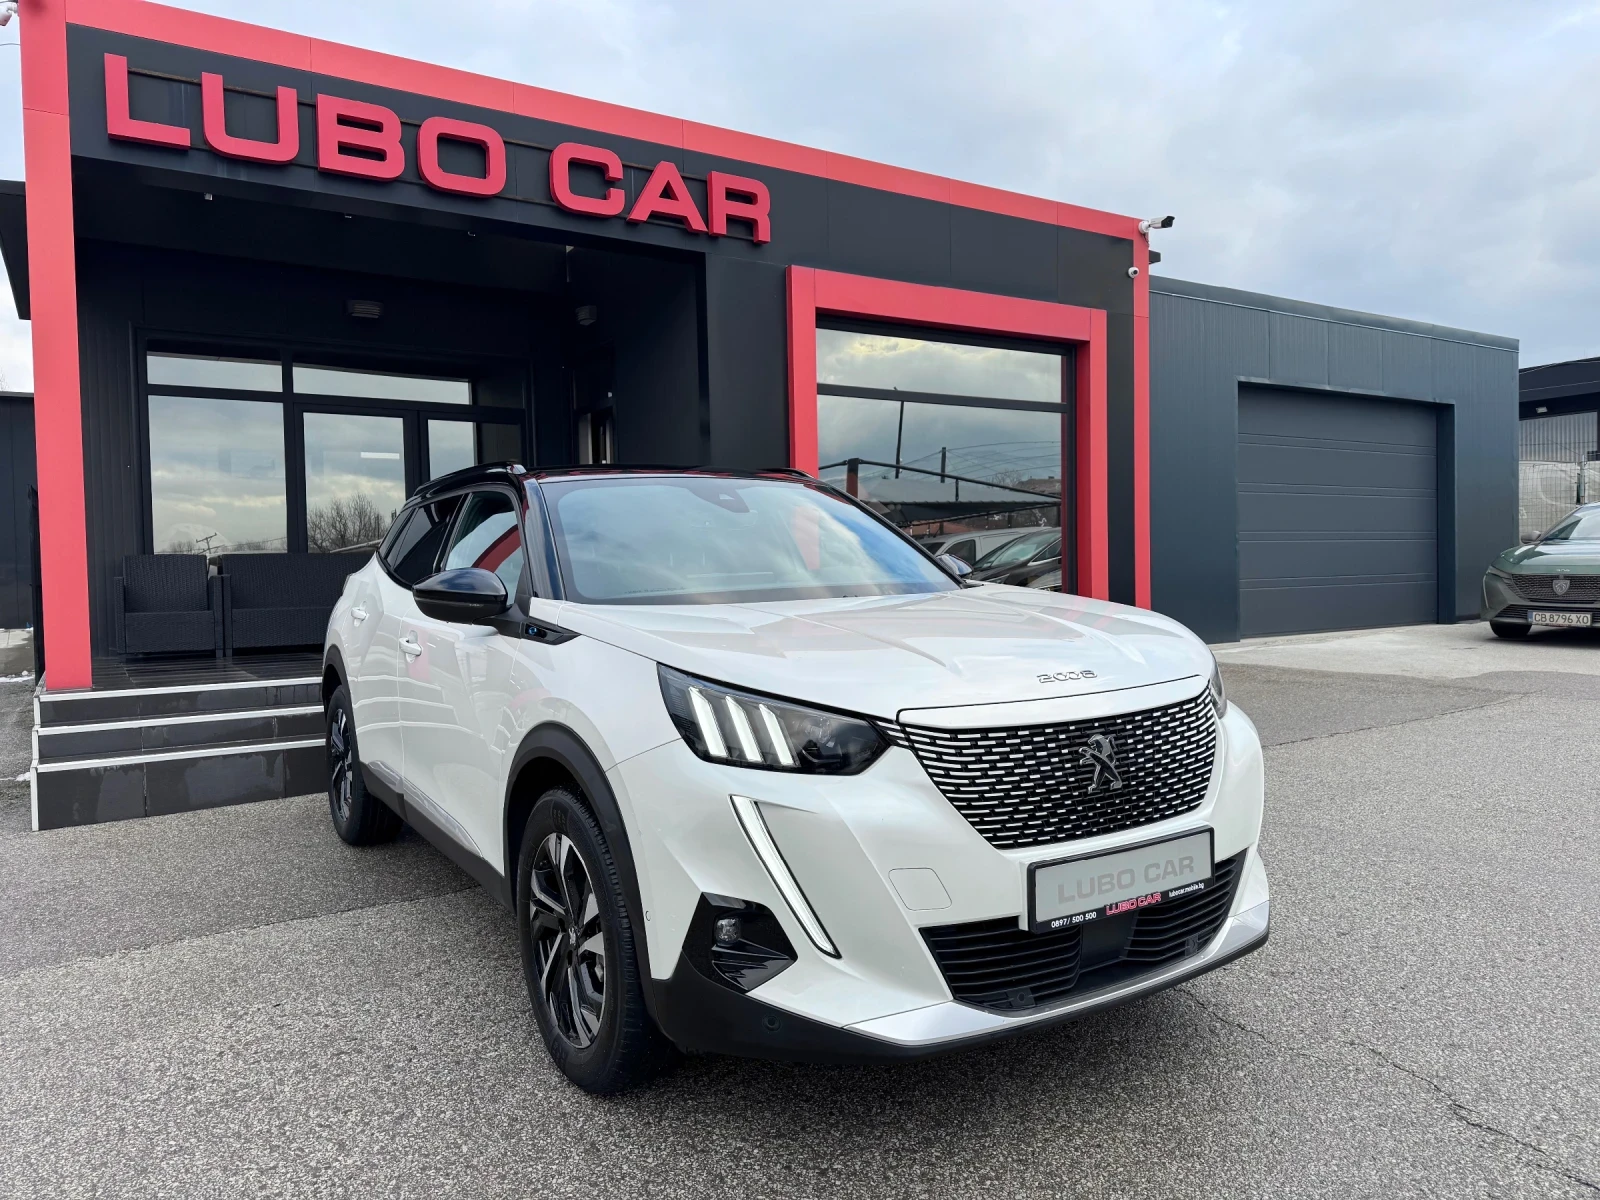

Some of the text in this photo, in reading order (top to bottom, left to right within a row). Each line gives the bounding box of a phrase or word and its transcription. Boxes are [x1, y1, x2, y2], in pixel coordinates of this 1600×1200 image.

[104, 53, 771, 244] LUBO CAR
[1534, 613, 1589, 624] CB 8796 XO
[1037, 670, 1098, 683] 2008
[1058, 855, 1195, 905] LUBO CAR
[1072, 914, 1084, 924] 500
[1084, 911, 1097, 921] 500
[1105, 899, 1136, 915] LUBO
[1138, 892, 1161, 906] CAR
[1168, 882, 1204, 897] lubocar.mobile.bg
